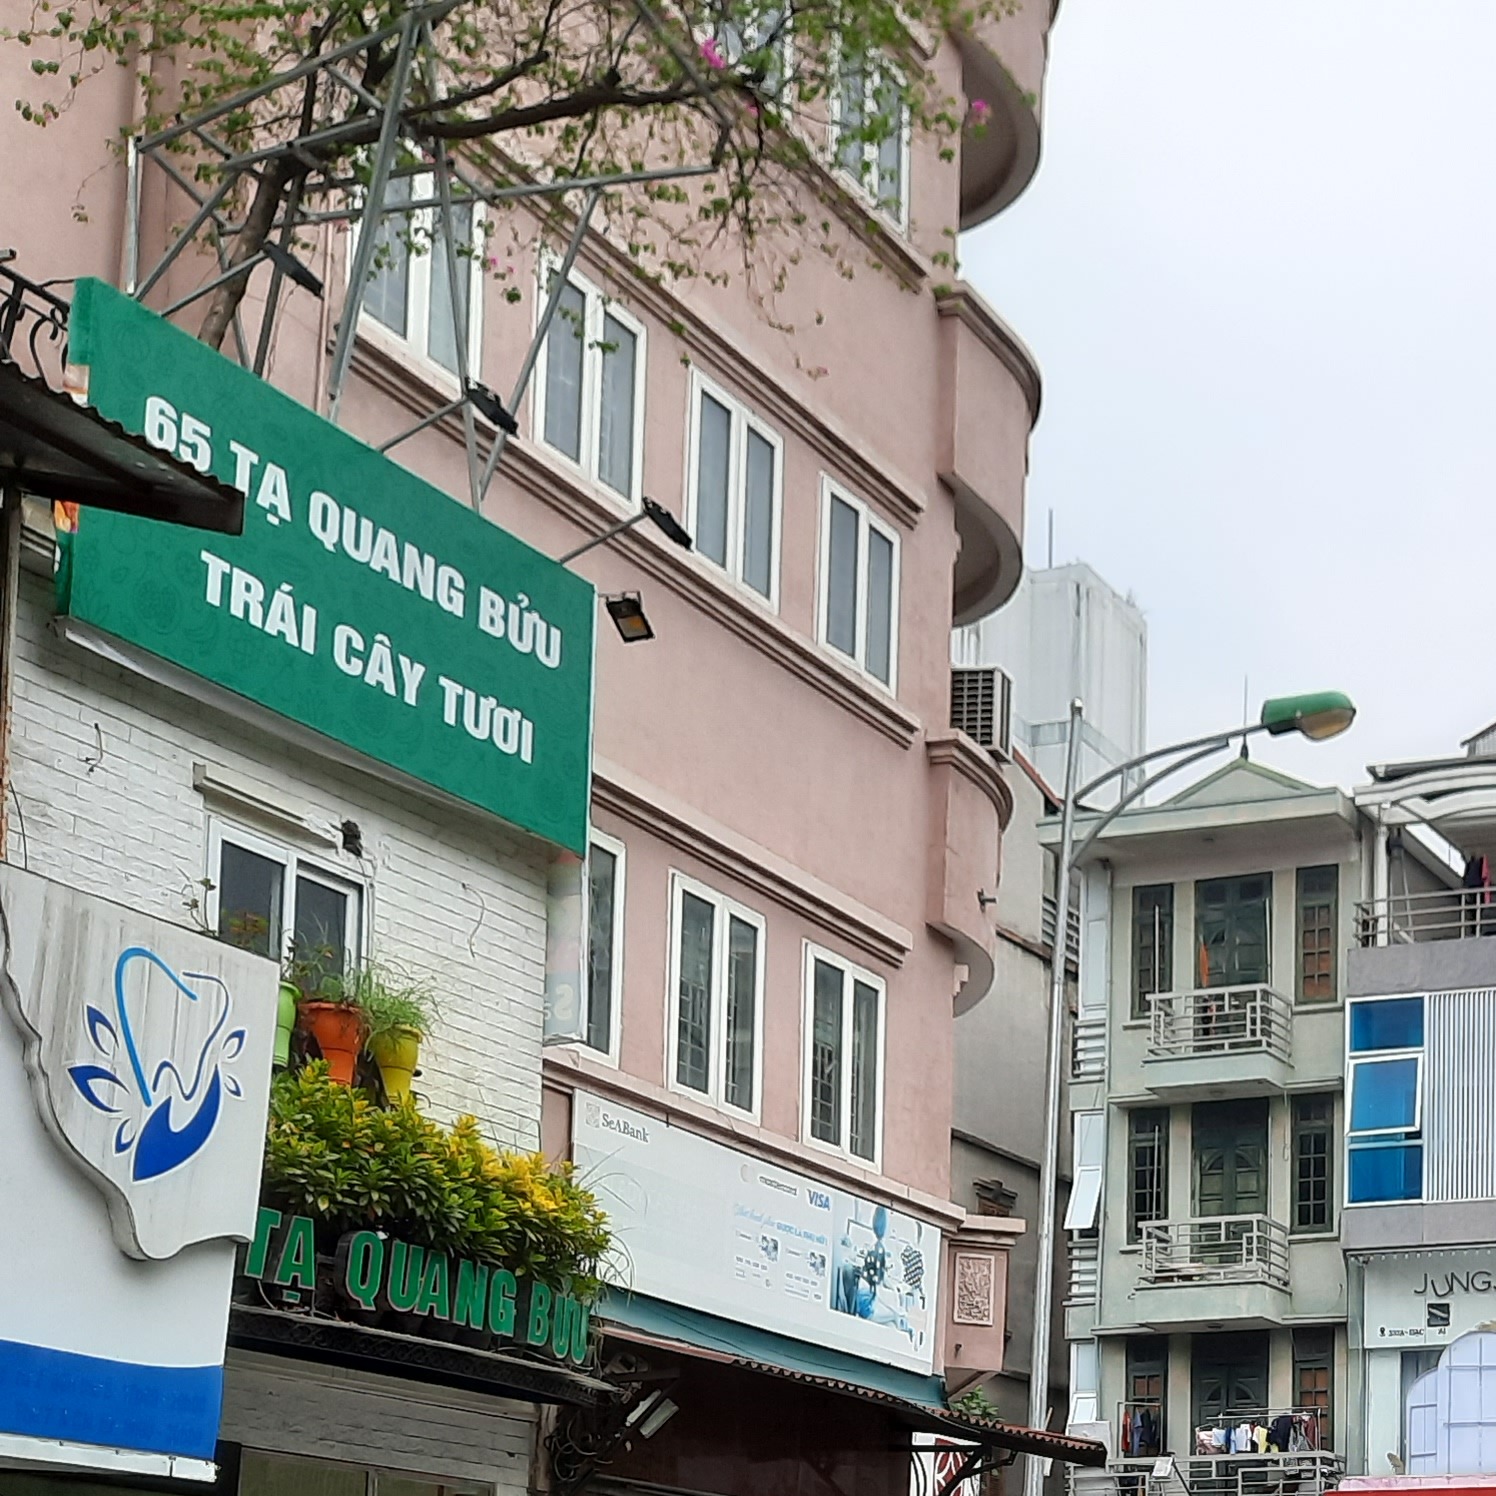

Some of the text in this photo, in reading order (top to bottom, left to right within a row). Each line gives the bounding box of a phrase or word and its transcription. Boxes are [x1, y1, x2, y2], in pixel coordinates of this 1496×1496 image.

[144, 395, 563, 670] 65 TẠ QUANG BỬU
[200, 550, 534, 764] TRÁI CÂY TƯƠI
[602, 1113, 650, 1143] SeABank
[806, 1189, 831, 1211] VISA
[243, 1206, 316, 1303] TẠ
[347, 1230, 517, 1337] QUANG
